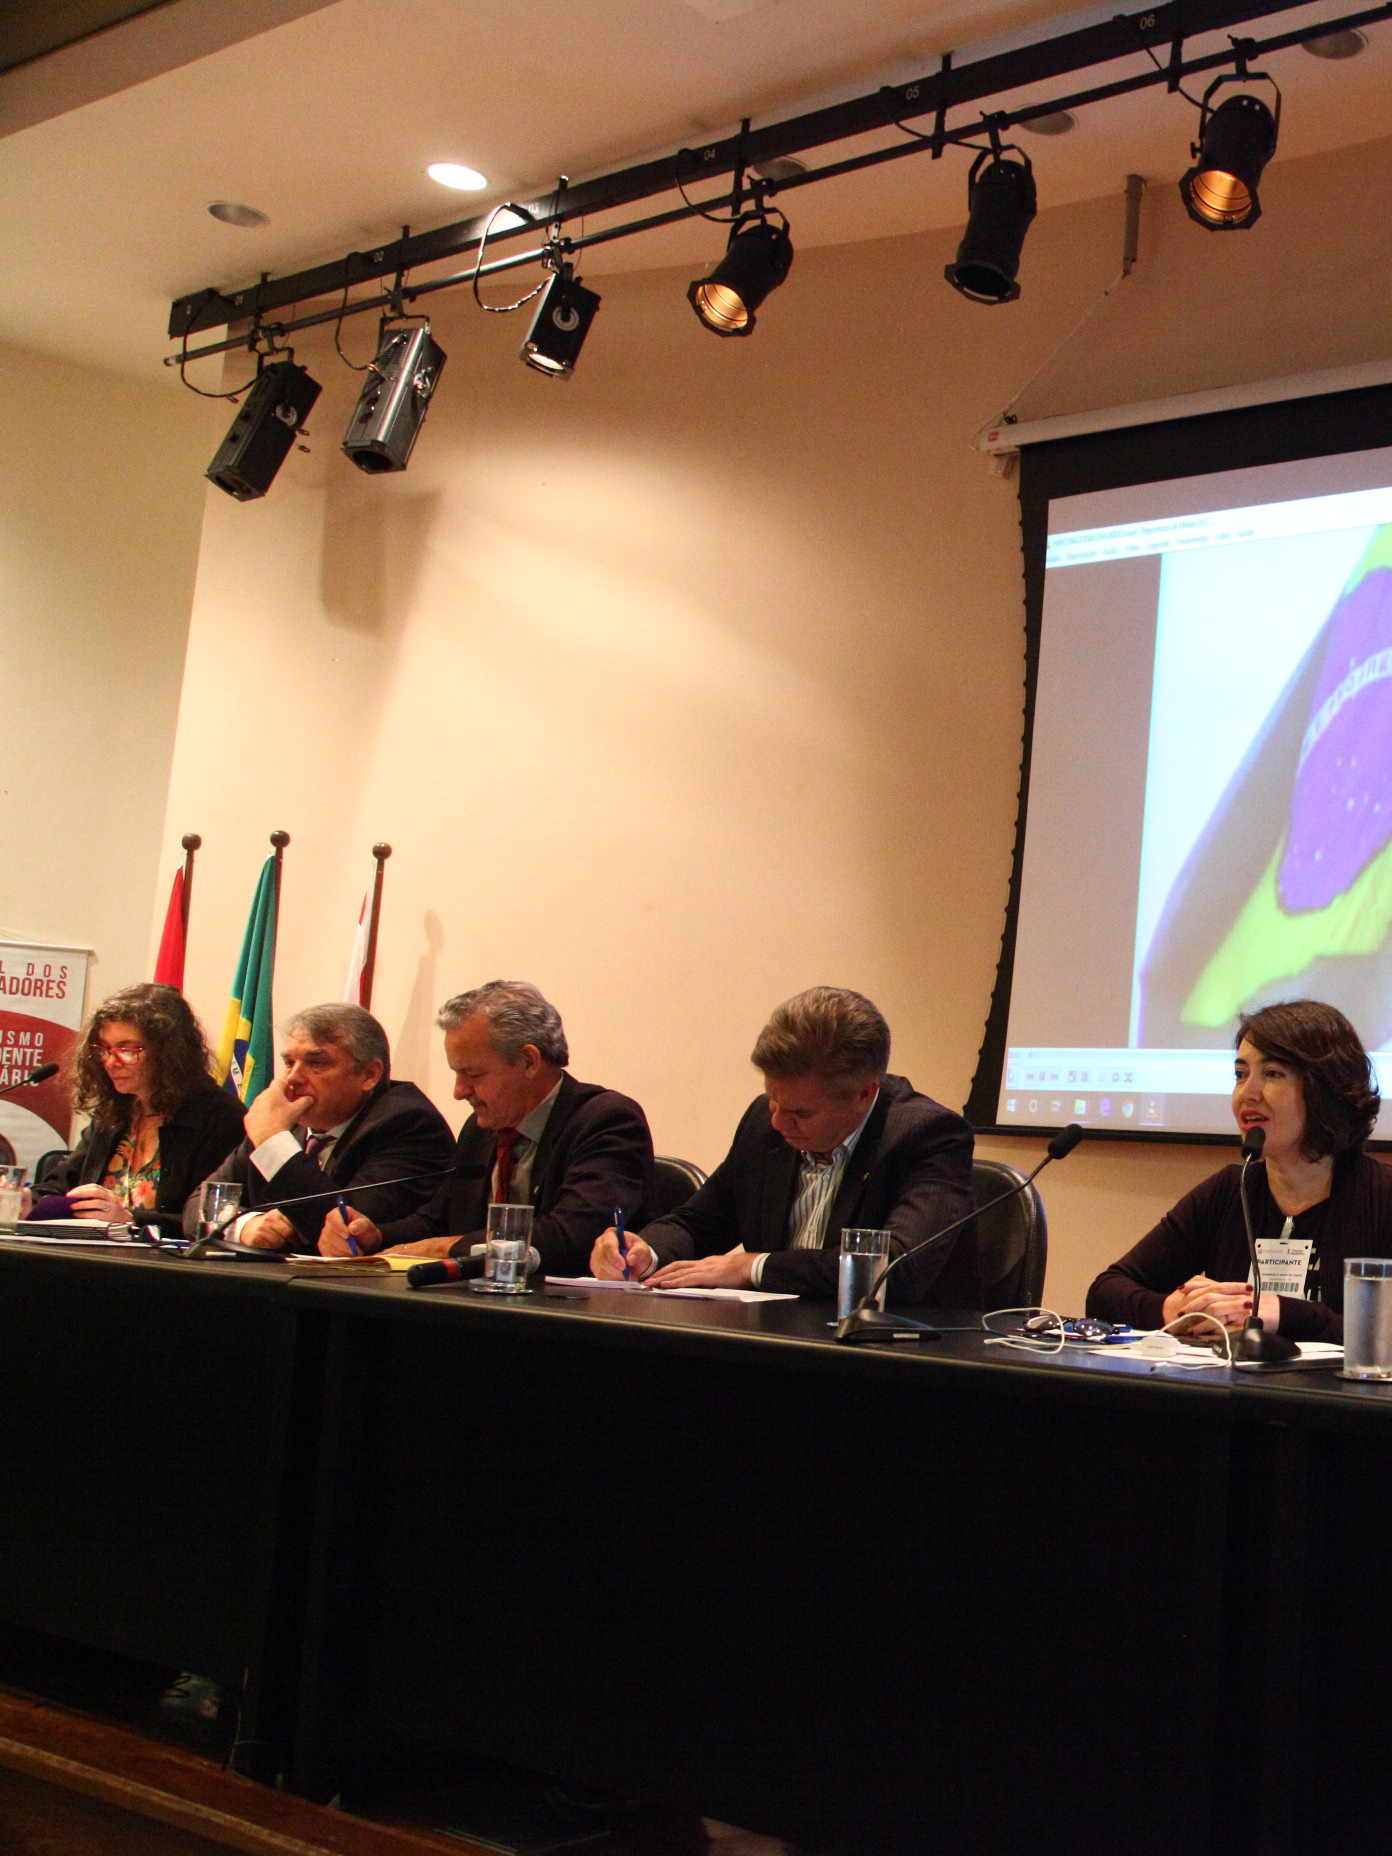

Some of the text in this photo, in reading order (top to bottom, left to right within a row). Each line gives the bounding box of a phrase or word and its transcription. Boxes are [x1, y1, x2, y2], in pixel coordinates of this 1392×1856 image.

[1140, 14, 1155, 30] 06
[906, 85, 920, 100] 05
[704, 148, 716, 161] 04
[26, 962, 68, 980] DOS
[0, 976, 67, 1000] ADORES
[0, 1047, 44, 1067] ENTE
[1257, 1258, 1301, 1266] PARTICIPANTE
